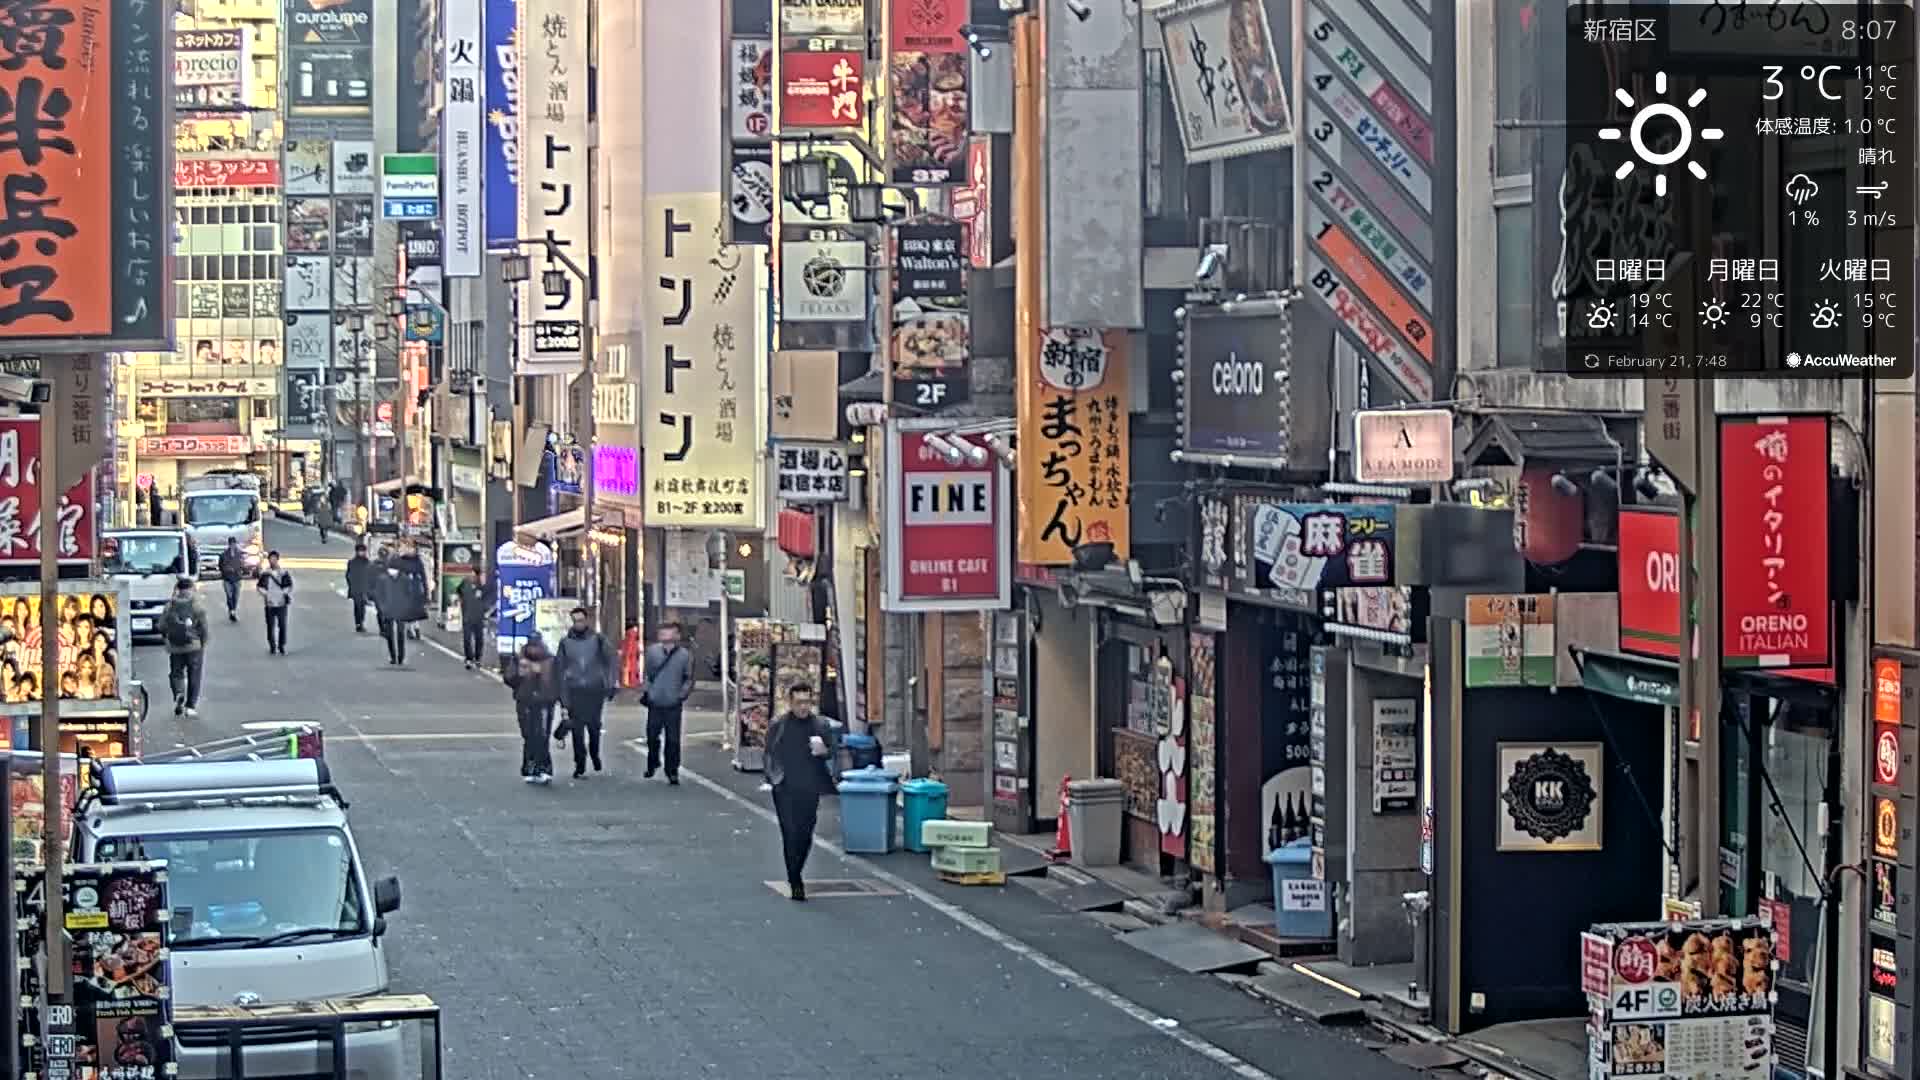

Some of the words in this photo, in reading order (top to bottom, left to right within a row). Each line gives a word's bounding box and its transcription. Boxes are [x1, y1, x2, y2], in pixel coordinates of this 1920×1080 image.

[1313, 21, 1335, 42] 5
[809, 39, 837, 51] 2F
[449, 38, 475, 104] 火鍋
[542, 13, 569, 123] 焼とん酒場
[1314, 73, 1334, 91] 4
[1314, 121, 1334, 142] 3
[911, 169, 950, 182] 3F
[1312, 170, 1334, 193] 2
[903, 239, 930, 253] BBQ
[900, 255, 959, 270] Walton's
[1311, 268, 1340, 298] B1
[660, 208, 692, 462] トントン
[712, 322, 738, 444] 焼とん酒場
[1212, 351, 1264, 396] celona
[916, 383, 947, 404] 2F
[780, 449, 844, 472] 酒場心
[1040, 395, 1086, 548] まっちゃん
[654, 477, 750, 495] 新宿歌舞伎町店
[780, 473, 843, 492] 新宿本店
[911, 483, 986, 513] FINE
[1349, 519, 1390, 535] フリー
[1754, 430, 1790, 604] 俺のイタリアン
[910, 559, 954, 574] ONLINE
[957, 558, 988, 574] CAFE
[1740, 613, 1808, 633] ORENO
[1740, 633, 1809, 651] ITALIAN
[1535, 781, 1563, 800] KK
[1616, 990, 1650, 1012] 4F
[1685, 992, 1768, 1014] 炭火焼き鳥
